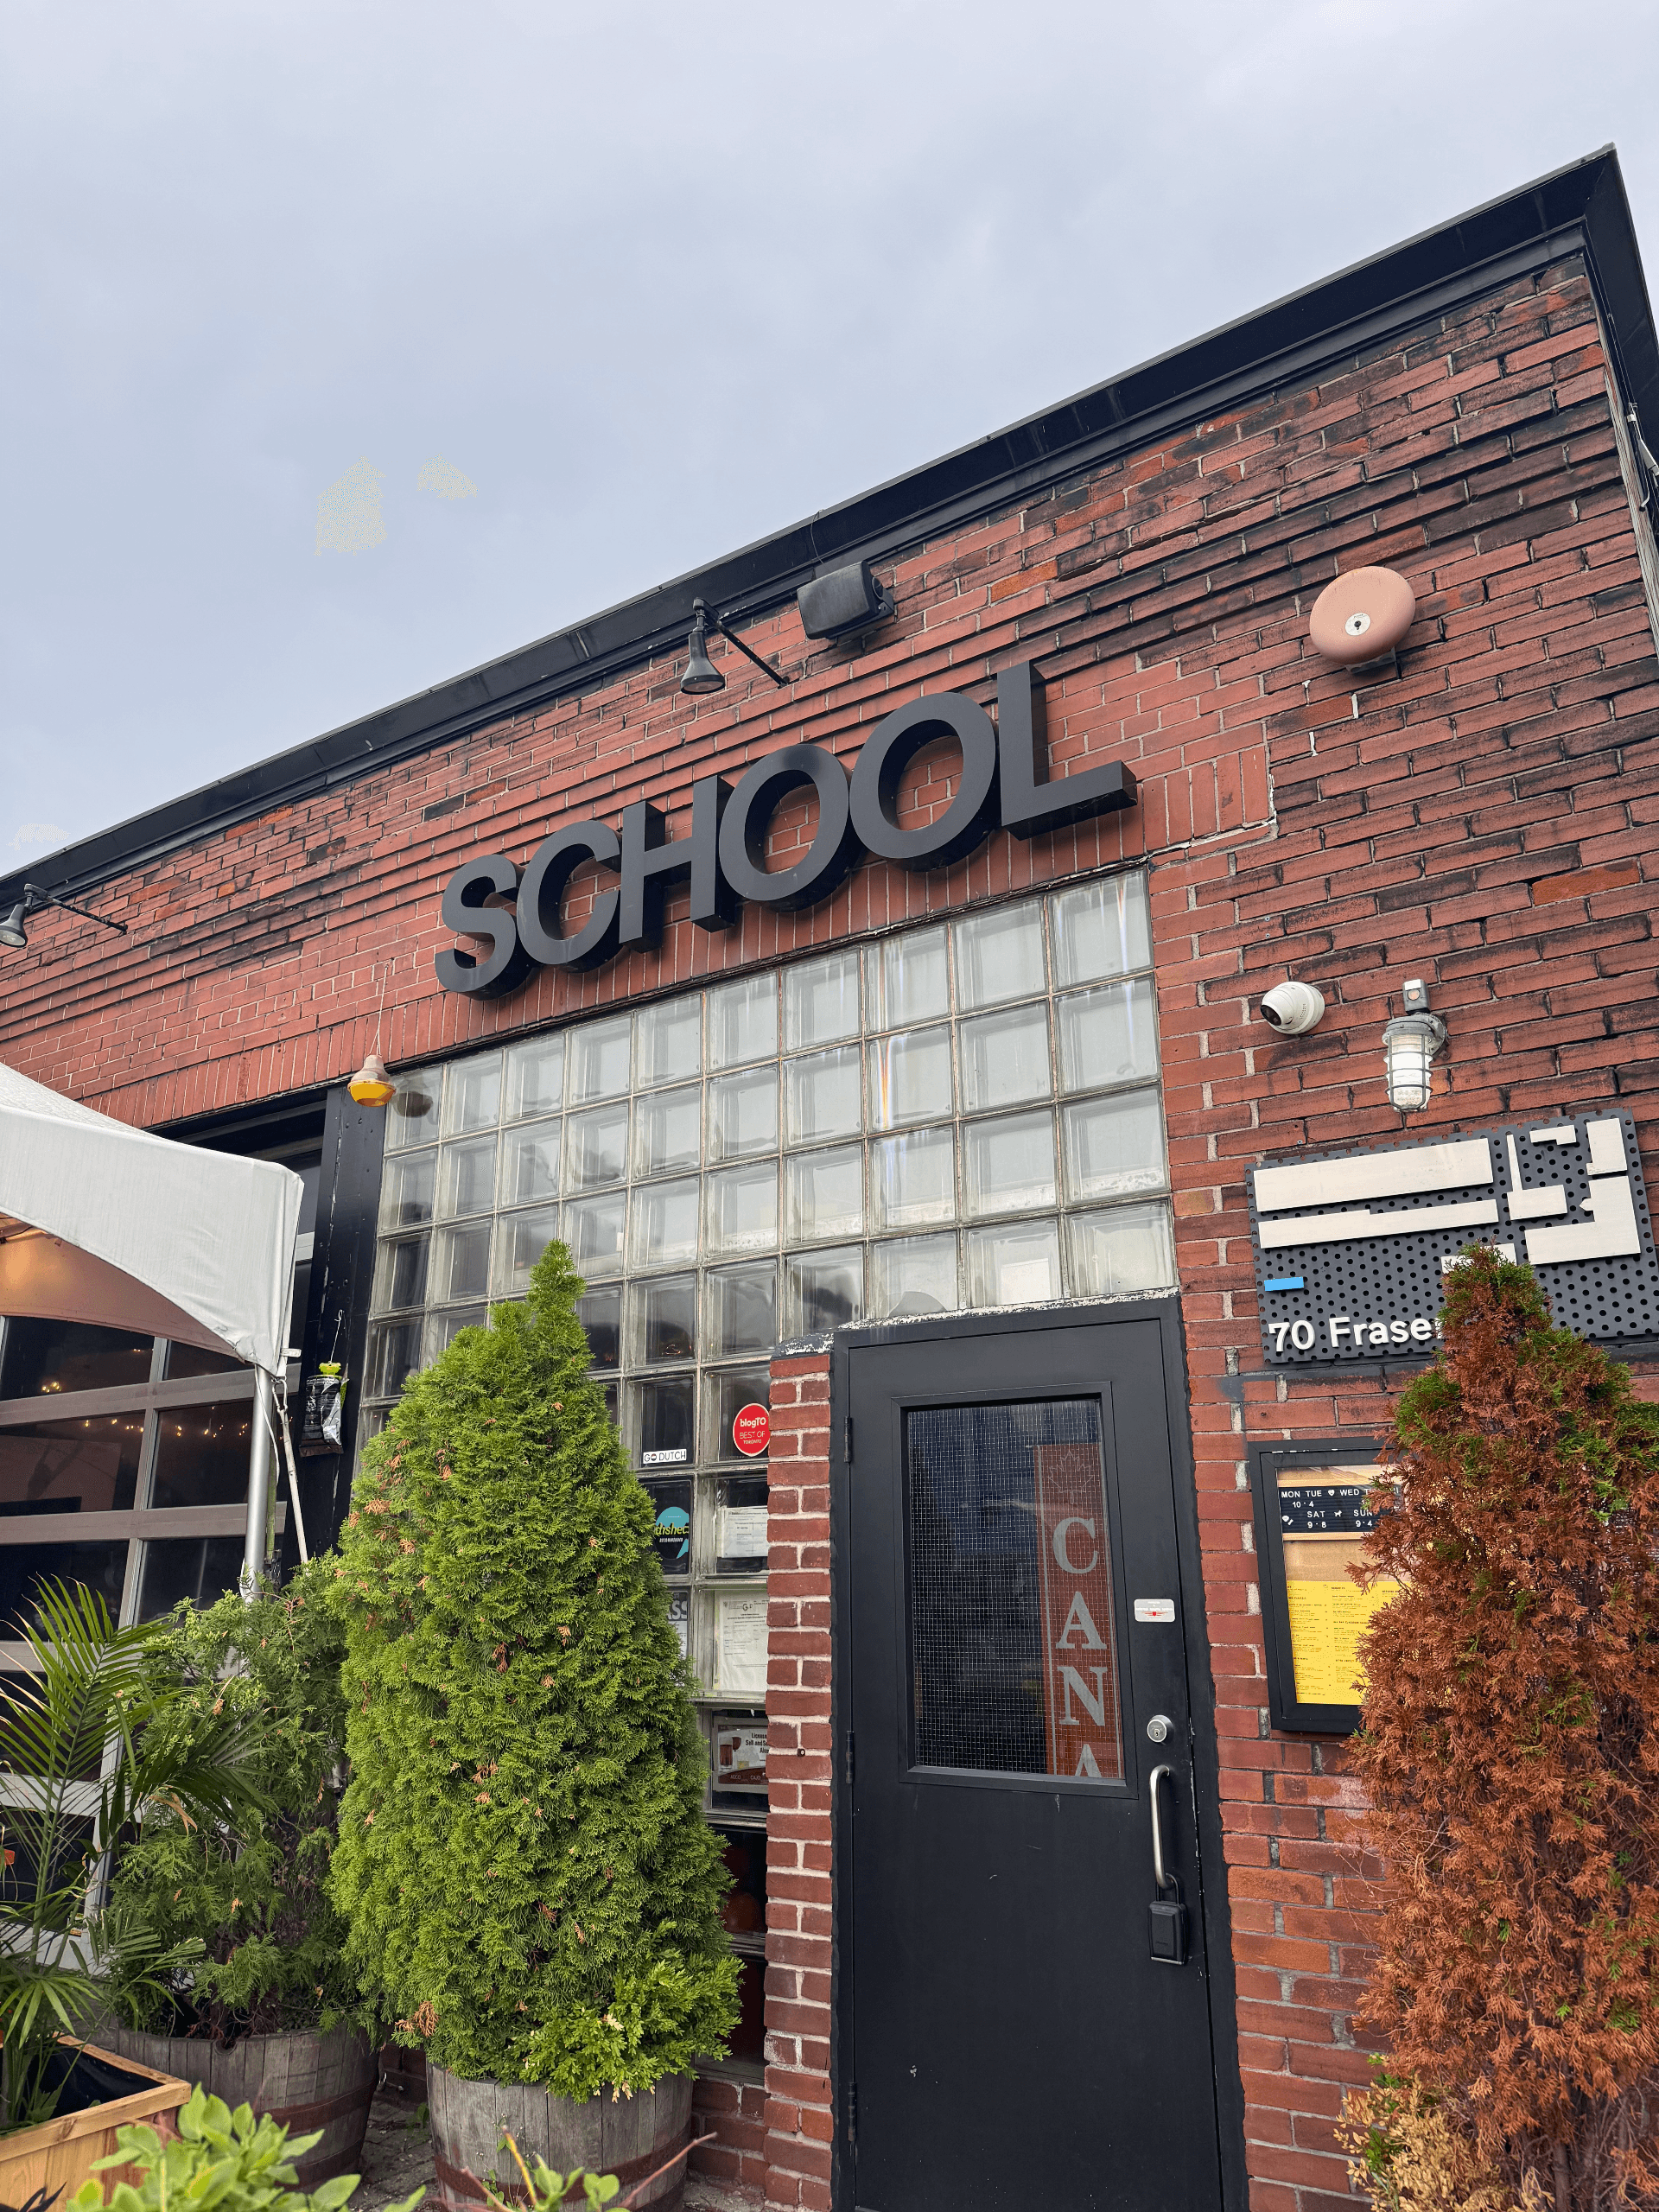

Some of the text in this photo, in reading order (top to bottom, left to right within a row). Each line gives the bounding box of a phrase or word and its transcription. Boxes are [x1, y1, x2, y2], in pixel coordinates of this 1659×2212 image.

[435, 660, 1136, 1001] SCHOOL
[1268, 1319, 1315, 1352] 70
[740, 1417, 766, 1428] blogTO
[644, 1450, 686, 1462] GO DUTCH
